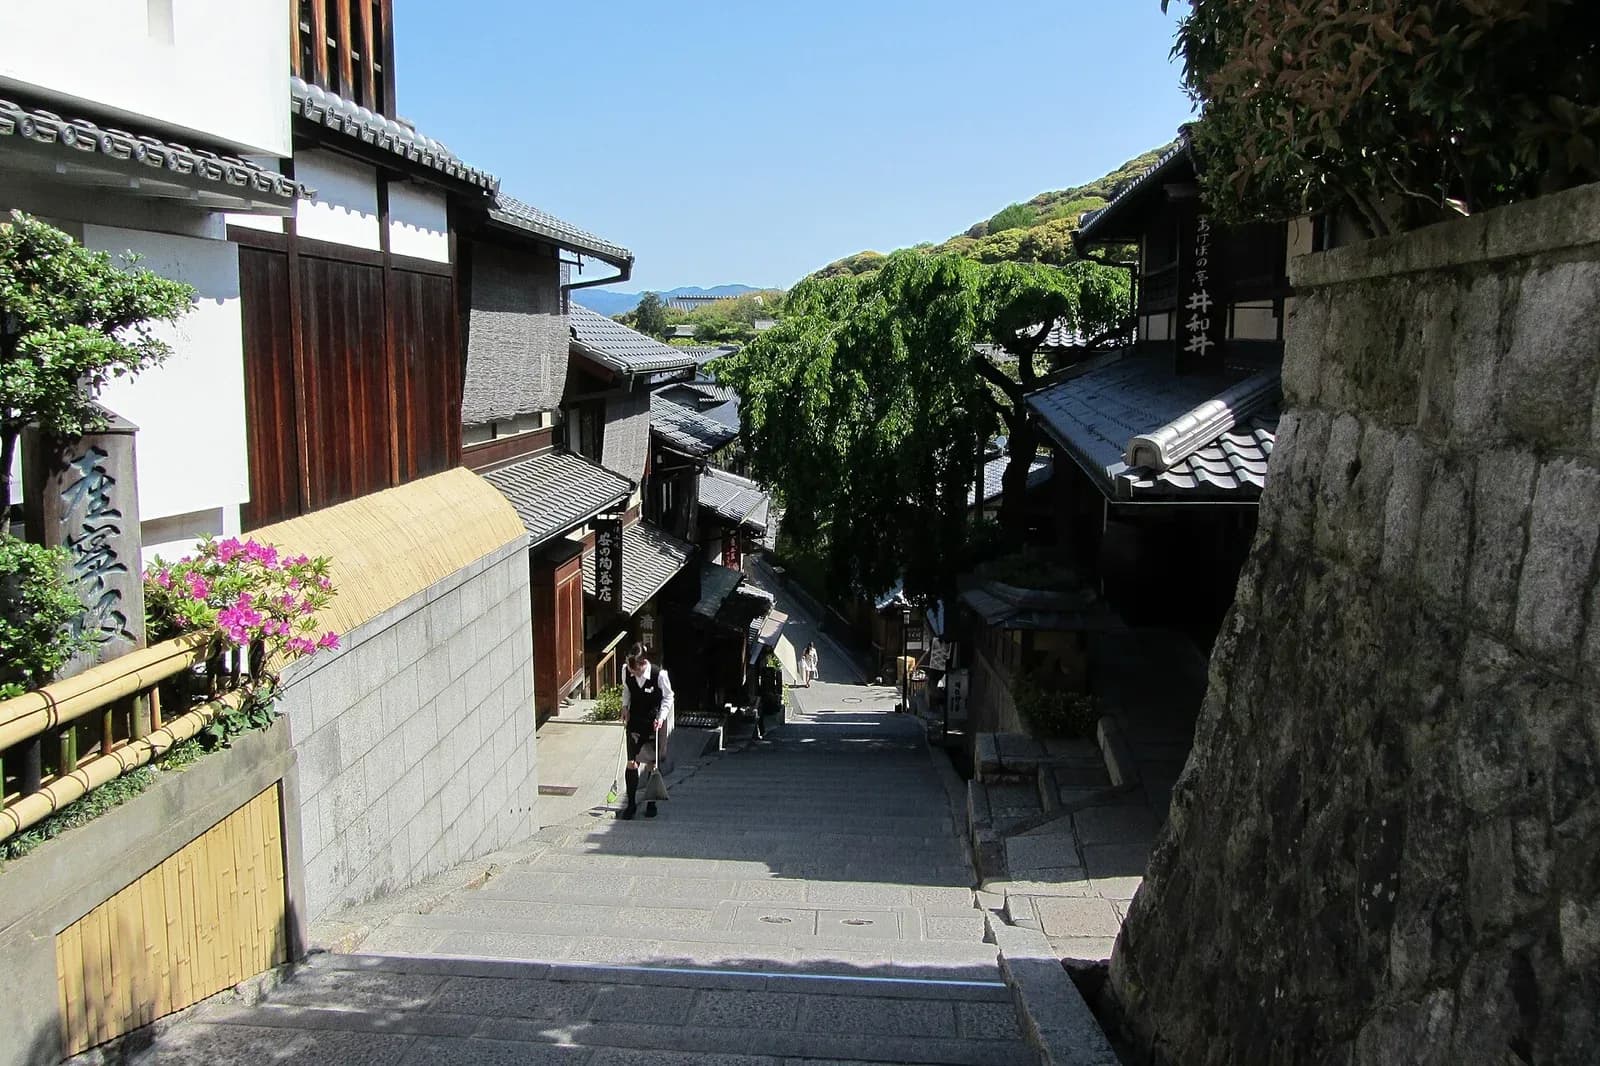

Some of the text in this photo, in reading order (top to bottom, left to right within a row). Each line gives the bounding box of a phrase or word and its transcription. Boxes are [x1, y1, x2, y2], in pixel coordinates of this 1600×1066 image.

[1184, 216, 1215, 357] あけぼの亭 井和井
